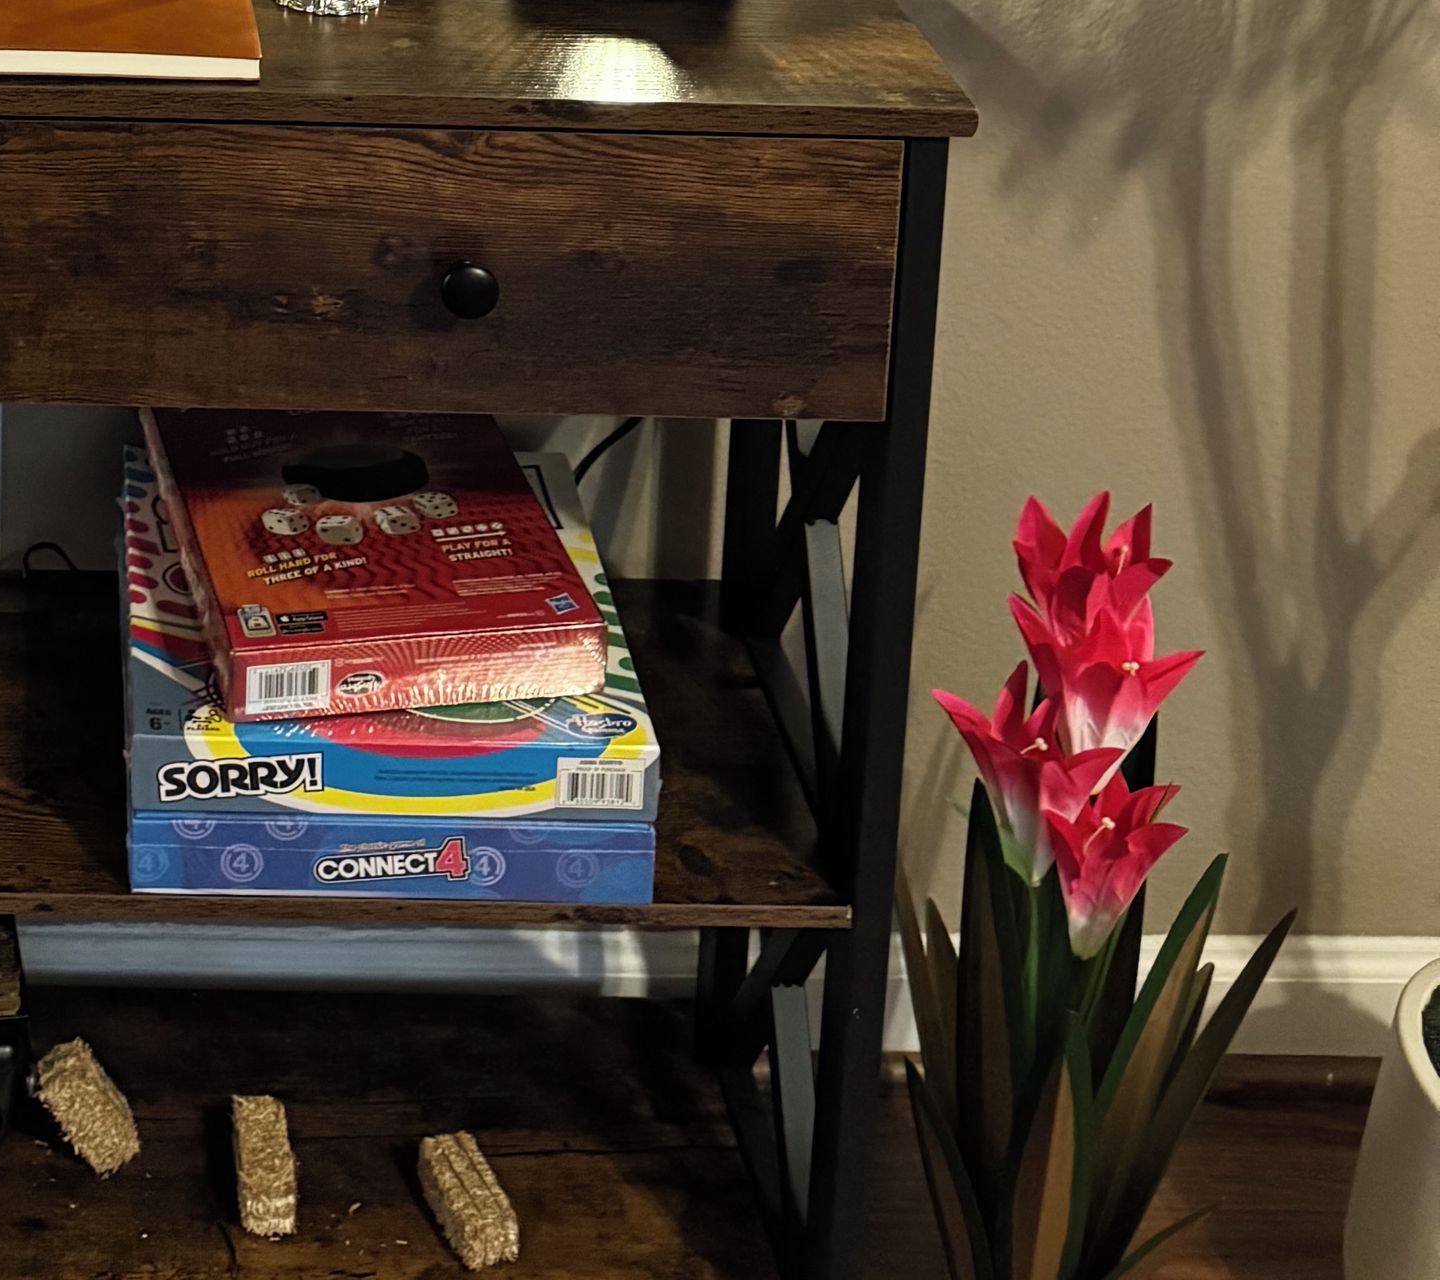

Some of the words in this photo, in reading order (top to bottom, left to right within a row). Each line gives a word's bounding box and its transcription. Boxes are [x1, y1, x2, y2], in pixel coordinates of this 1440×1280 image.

[441, 541, 471, 553] PLAY
[474, 539, 499, 549] FOR
[502, 538, 513, 546] A
[448, 548, 513, 562] STRAIGHT!
[246, 566, 277, 578] ROLL
[279, 557, 312, 570] HARD
[313, 551, 337, 563] FOR
[263, 570, 302, 585] THREE
[304, 566, 320, 576] OF
[323, 563, 333, 572] A
[334, 556, 367, 570] KIND!
[566, 713, 633, 729] Hasbro
[161, 754, 320, 799] SORRY!
